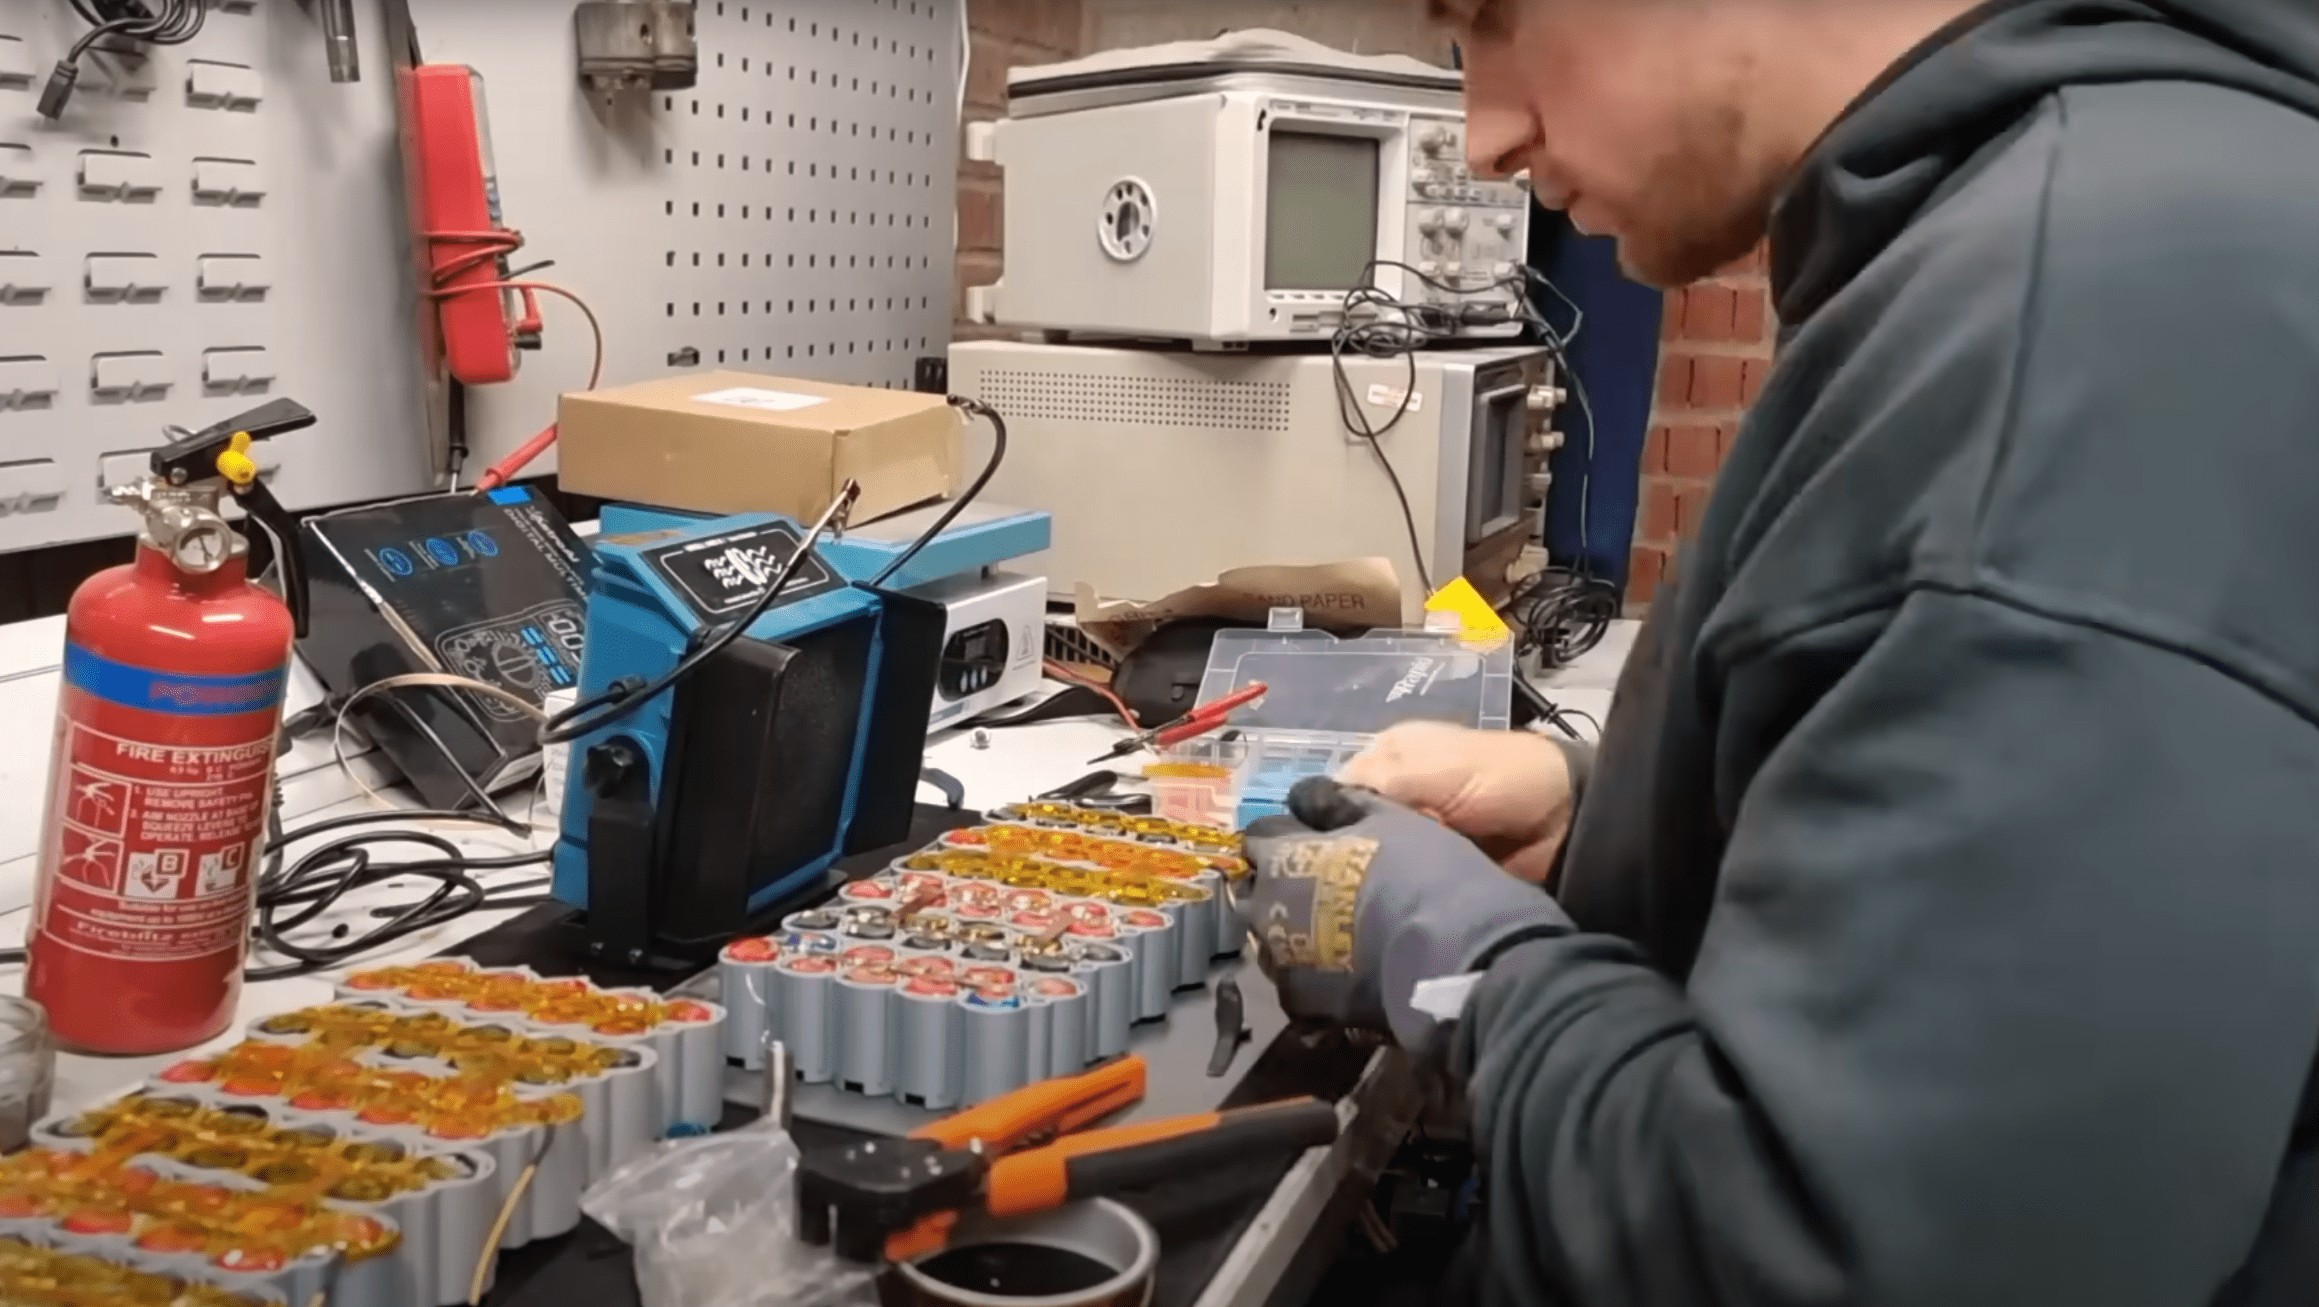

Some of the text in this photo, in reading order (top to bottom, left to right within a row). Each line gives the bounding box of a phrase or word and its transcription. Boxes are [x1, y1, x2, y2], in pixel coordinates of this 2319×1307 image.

[503, 507, 544, 553] DIGITAL
[1299, 592, 1366, 610] PAPER
[115, 741, 166, 764] FIRE
[145, 786, 170, 797] USE
[173, 786, 224, 798] UPRIGHT
[144, 797, 196, 810] REMOVE
[198, 795, 238, 809] SAFETY
[165, 811, 209, 822] NOZZLE
[210, 810, 225, 821] AT
[142, 820, 196, 832] SQUEEZE
[161, 854, 179, 872] B
[226, 848, 239, 866] C
